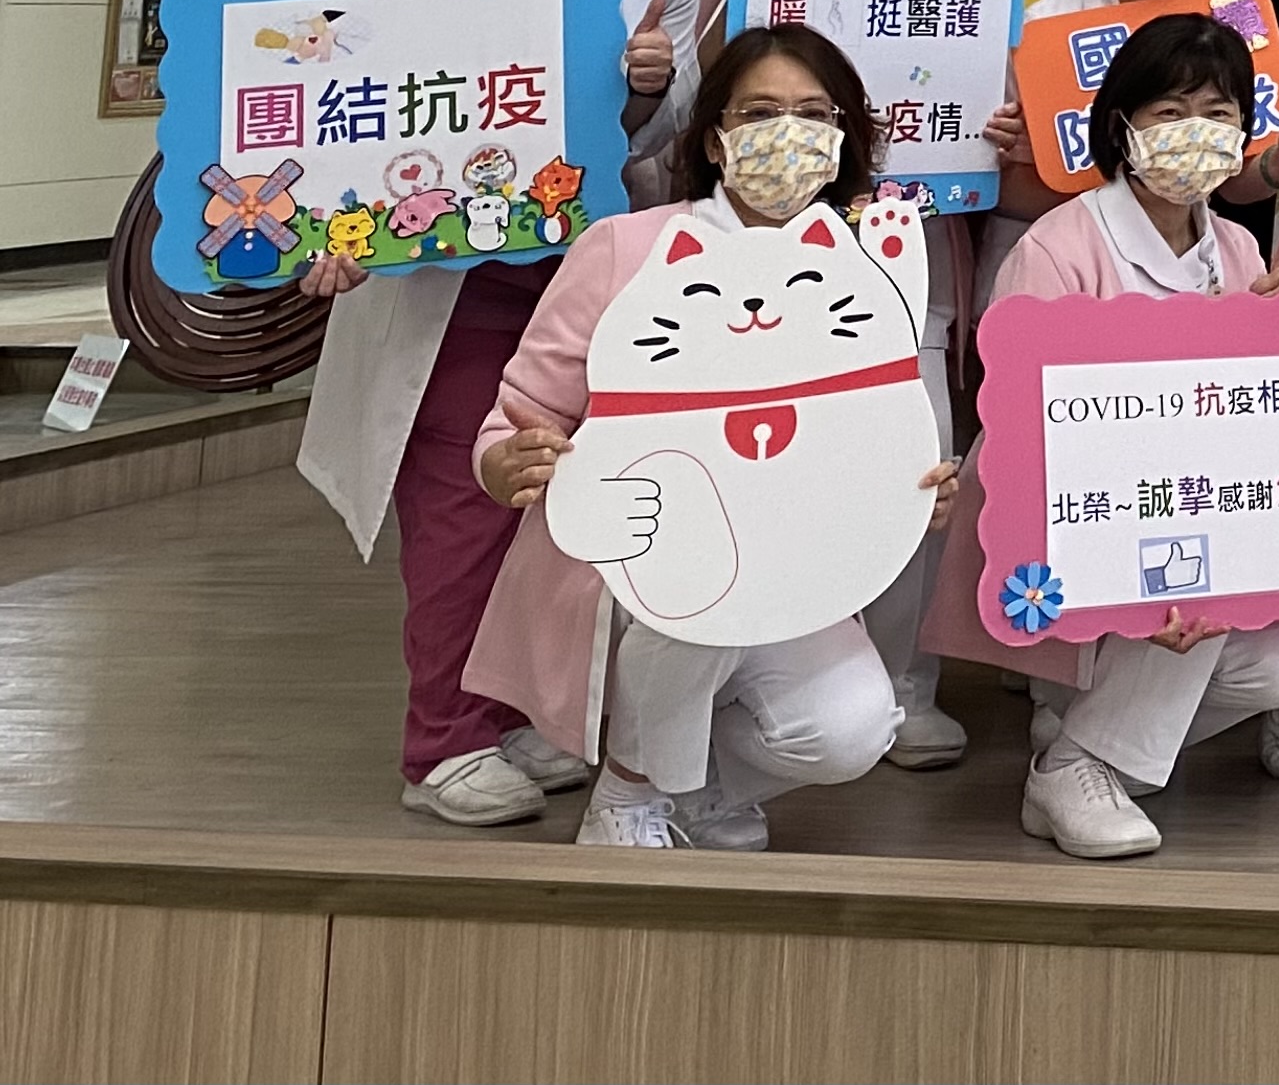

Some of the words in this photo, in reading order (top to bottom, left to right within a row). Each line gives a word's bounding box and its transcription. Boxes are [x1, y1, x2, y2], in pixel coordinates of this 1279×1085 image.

[236, 63, 548, 154] 團結抗疫
[1047, 393, 1184, 423] COVID-19
